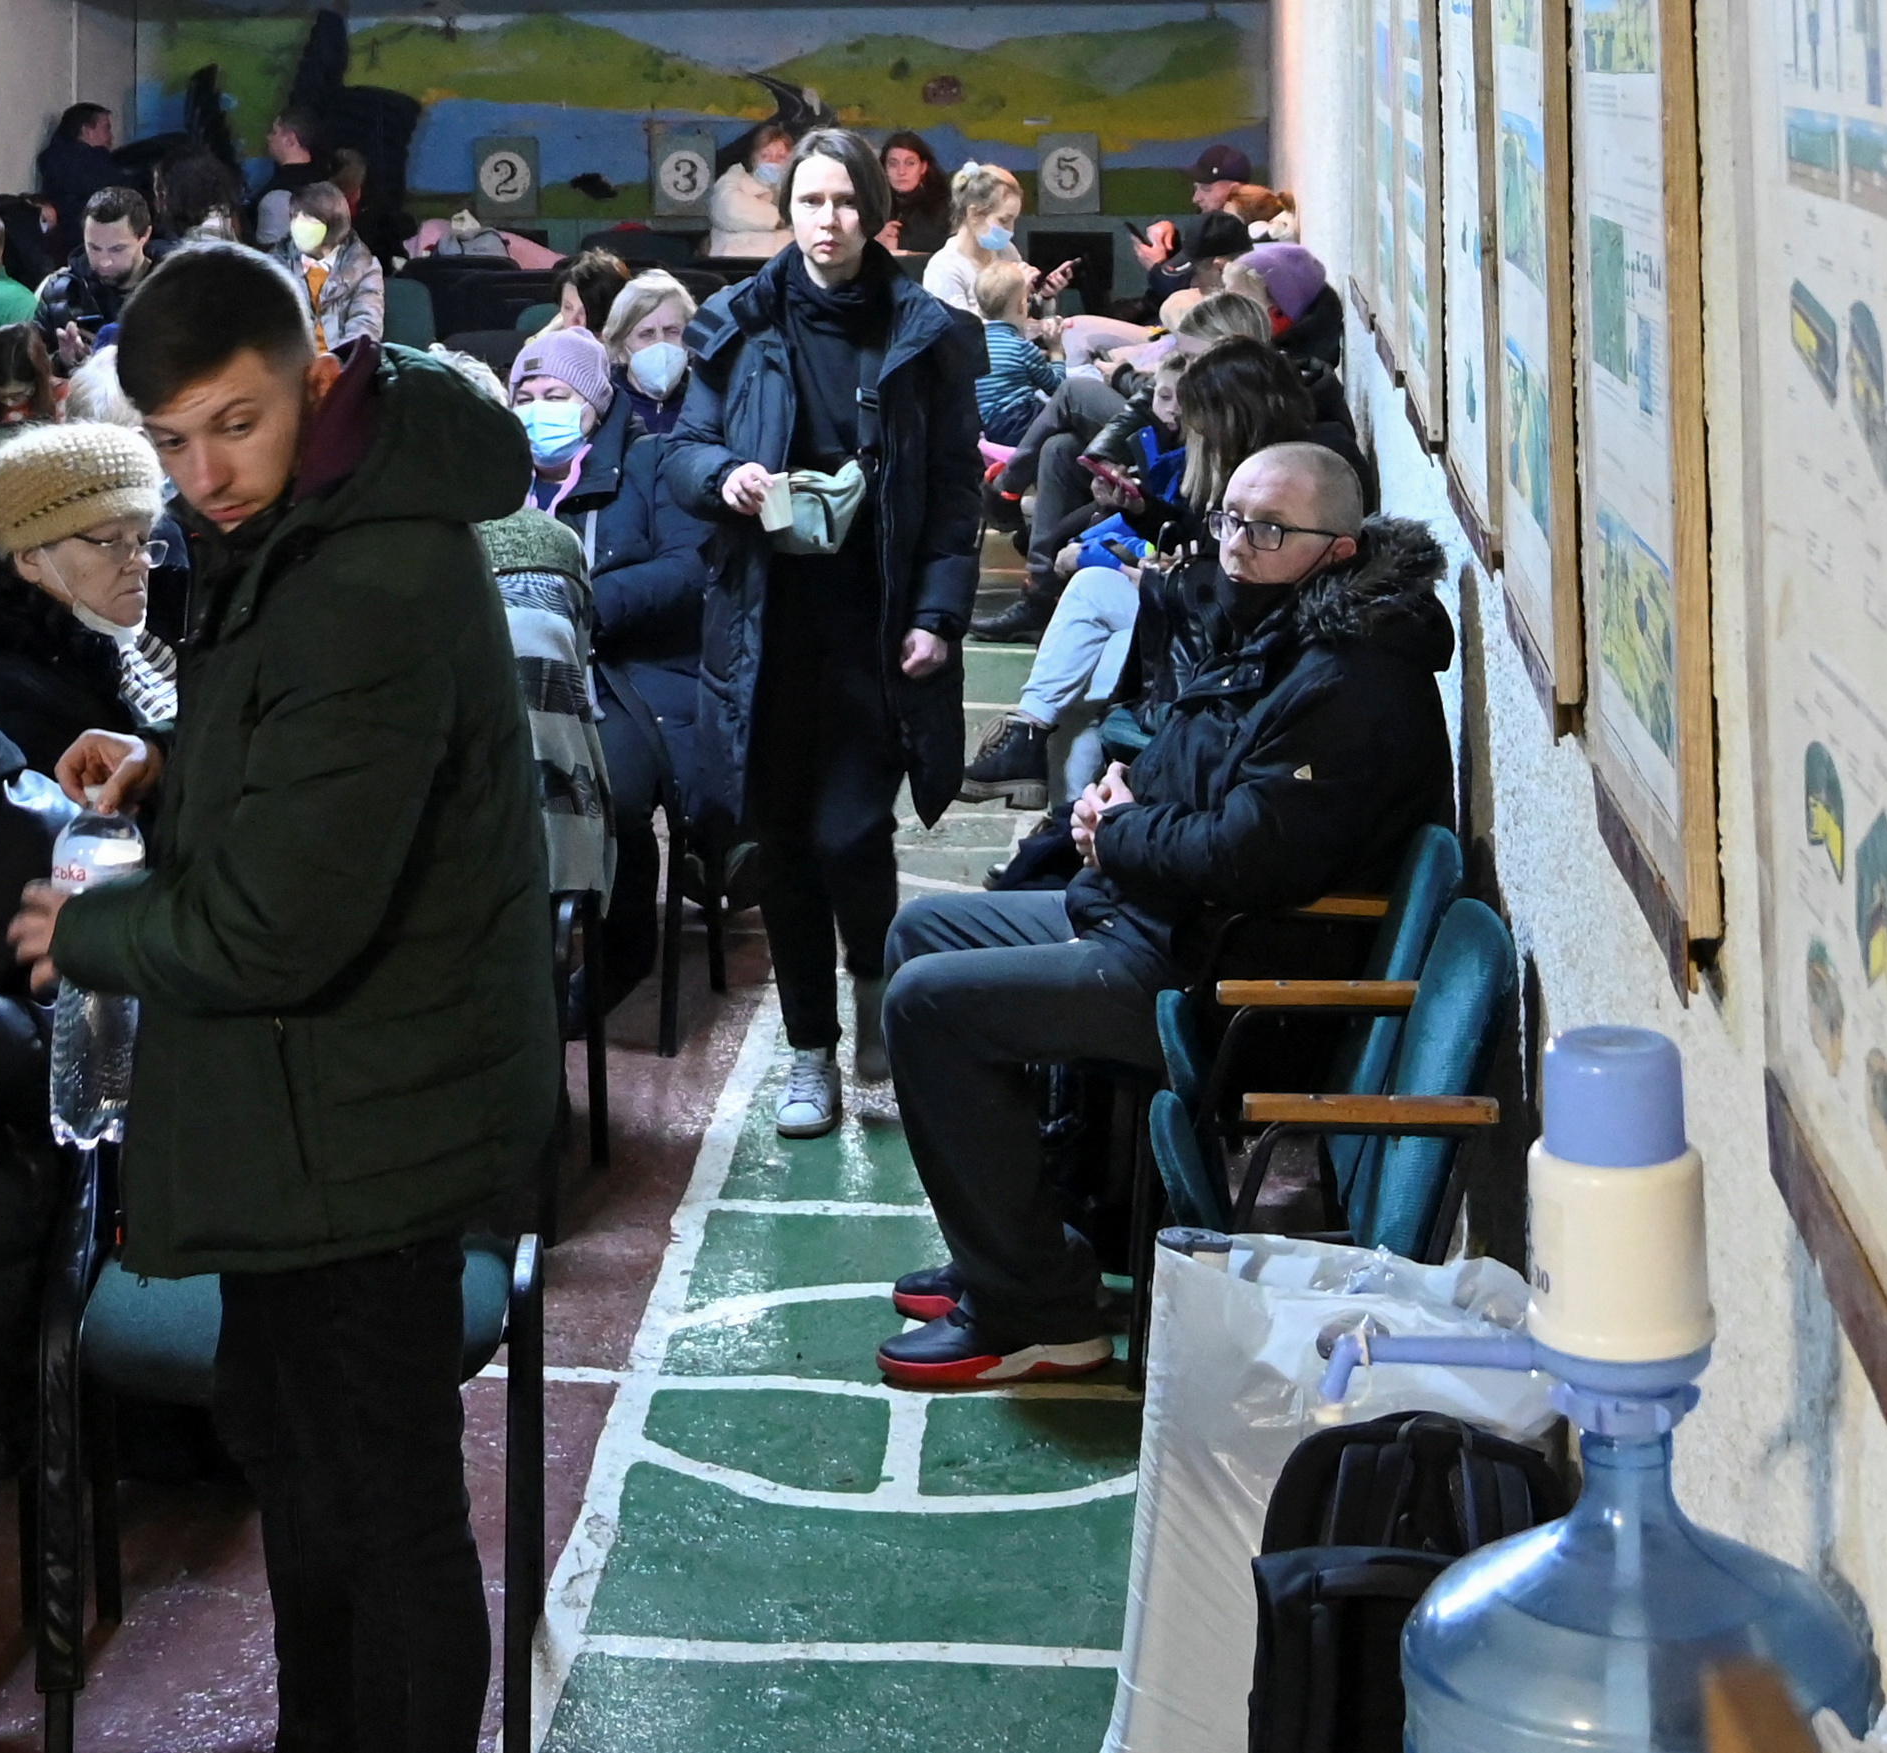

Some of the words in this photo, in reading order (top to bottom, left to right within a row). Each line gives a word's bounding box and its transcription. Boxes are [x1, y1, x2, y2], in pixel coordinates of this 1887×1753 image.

[495, 159, 516, 194] 2
[674, 159, 697, 194] 3
[1057, 157, 1080, 191] 5
[52, 864, 87, 882] ська
